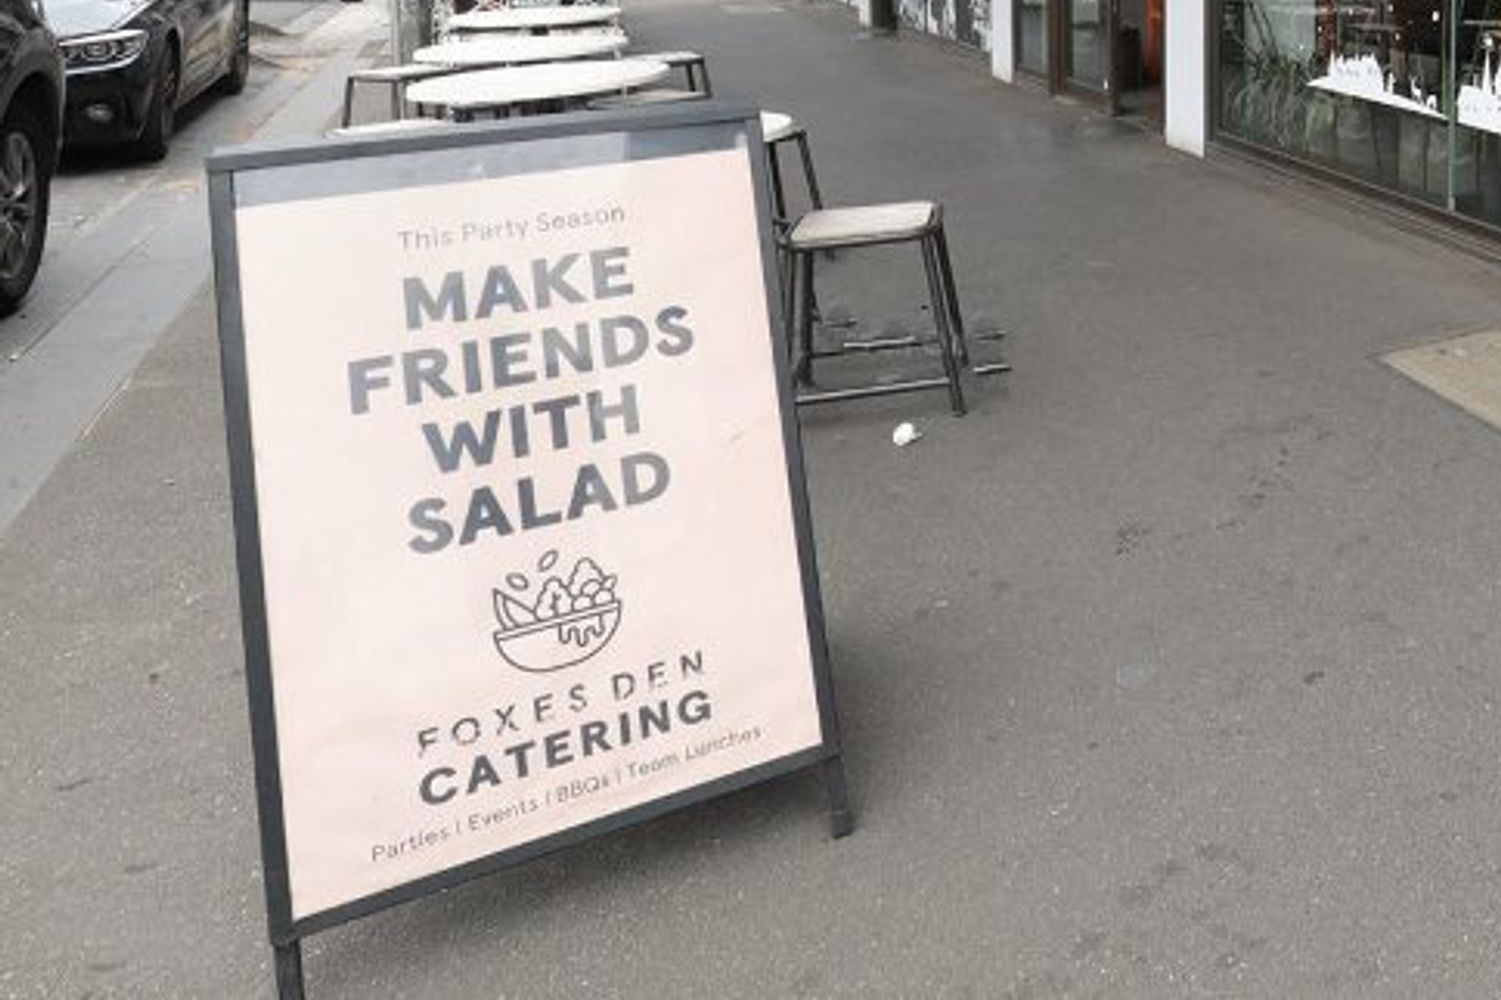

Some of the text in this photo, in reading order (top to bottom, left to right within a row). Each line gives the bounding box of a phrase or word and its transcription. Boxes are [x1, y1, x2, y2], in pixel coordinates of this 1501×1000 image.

[398, 205, 626, 251] This Party Season
[403, 246, 634, 331] MAKE
[347, 306, 694, 415] FRIENDS
[421, 384, 641, 474] WITH
[408, 452, 671, 555] SALAD
[417, 650, 706, 758] FOXES DEN
[419, 690, 713, 806] CATERING
[371, 726, 762, 862] Parties Events BBQs Team Lunches
